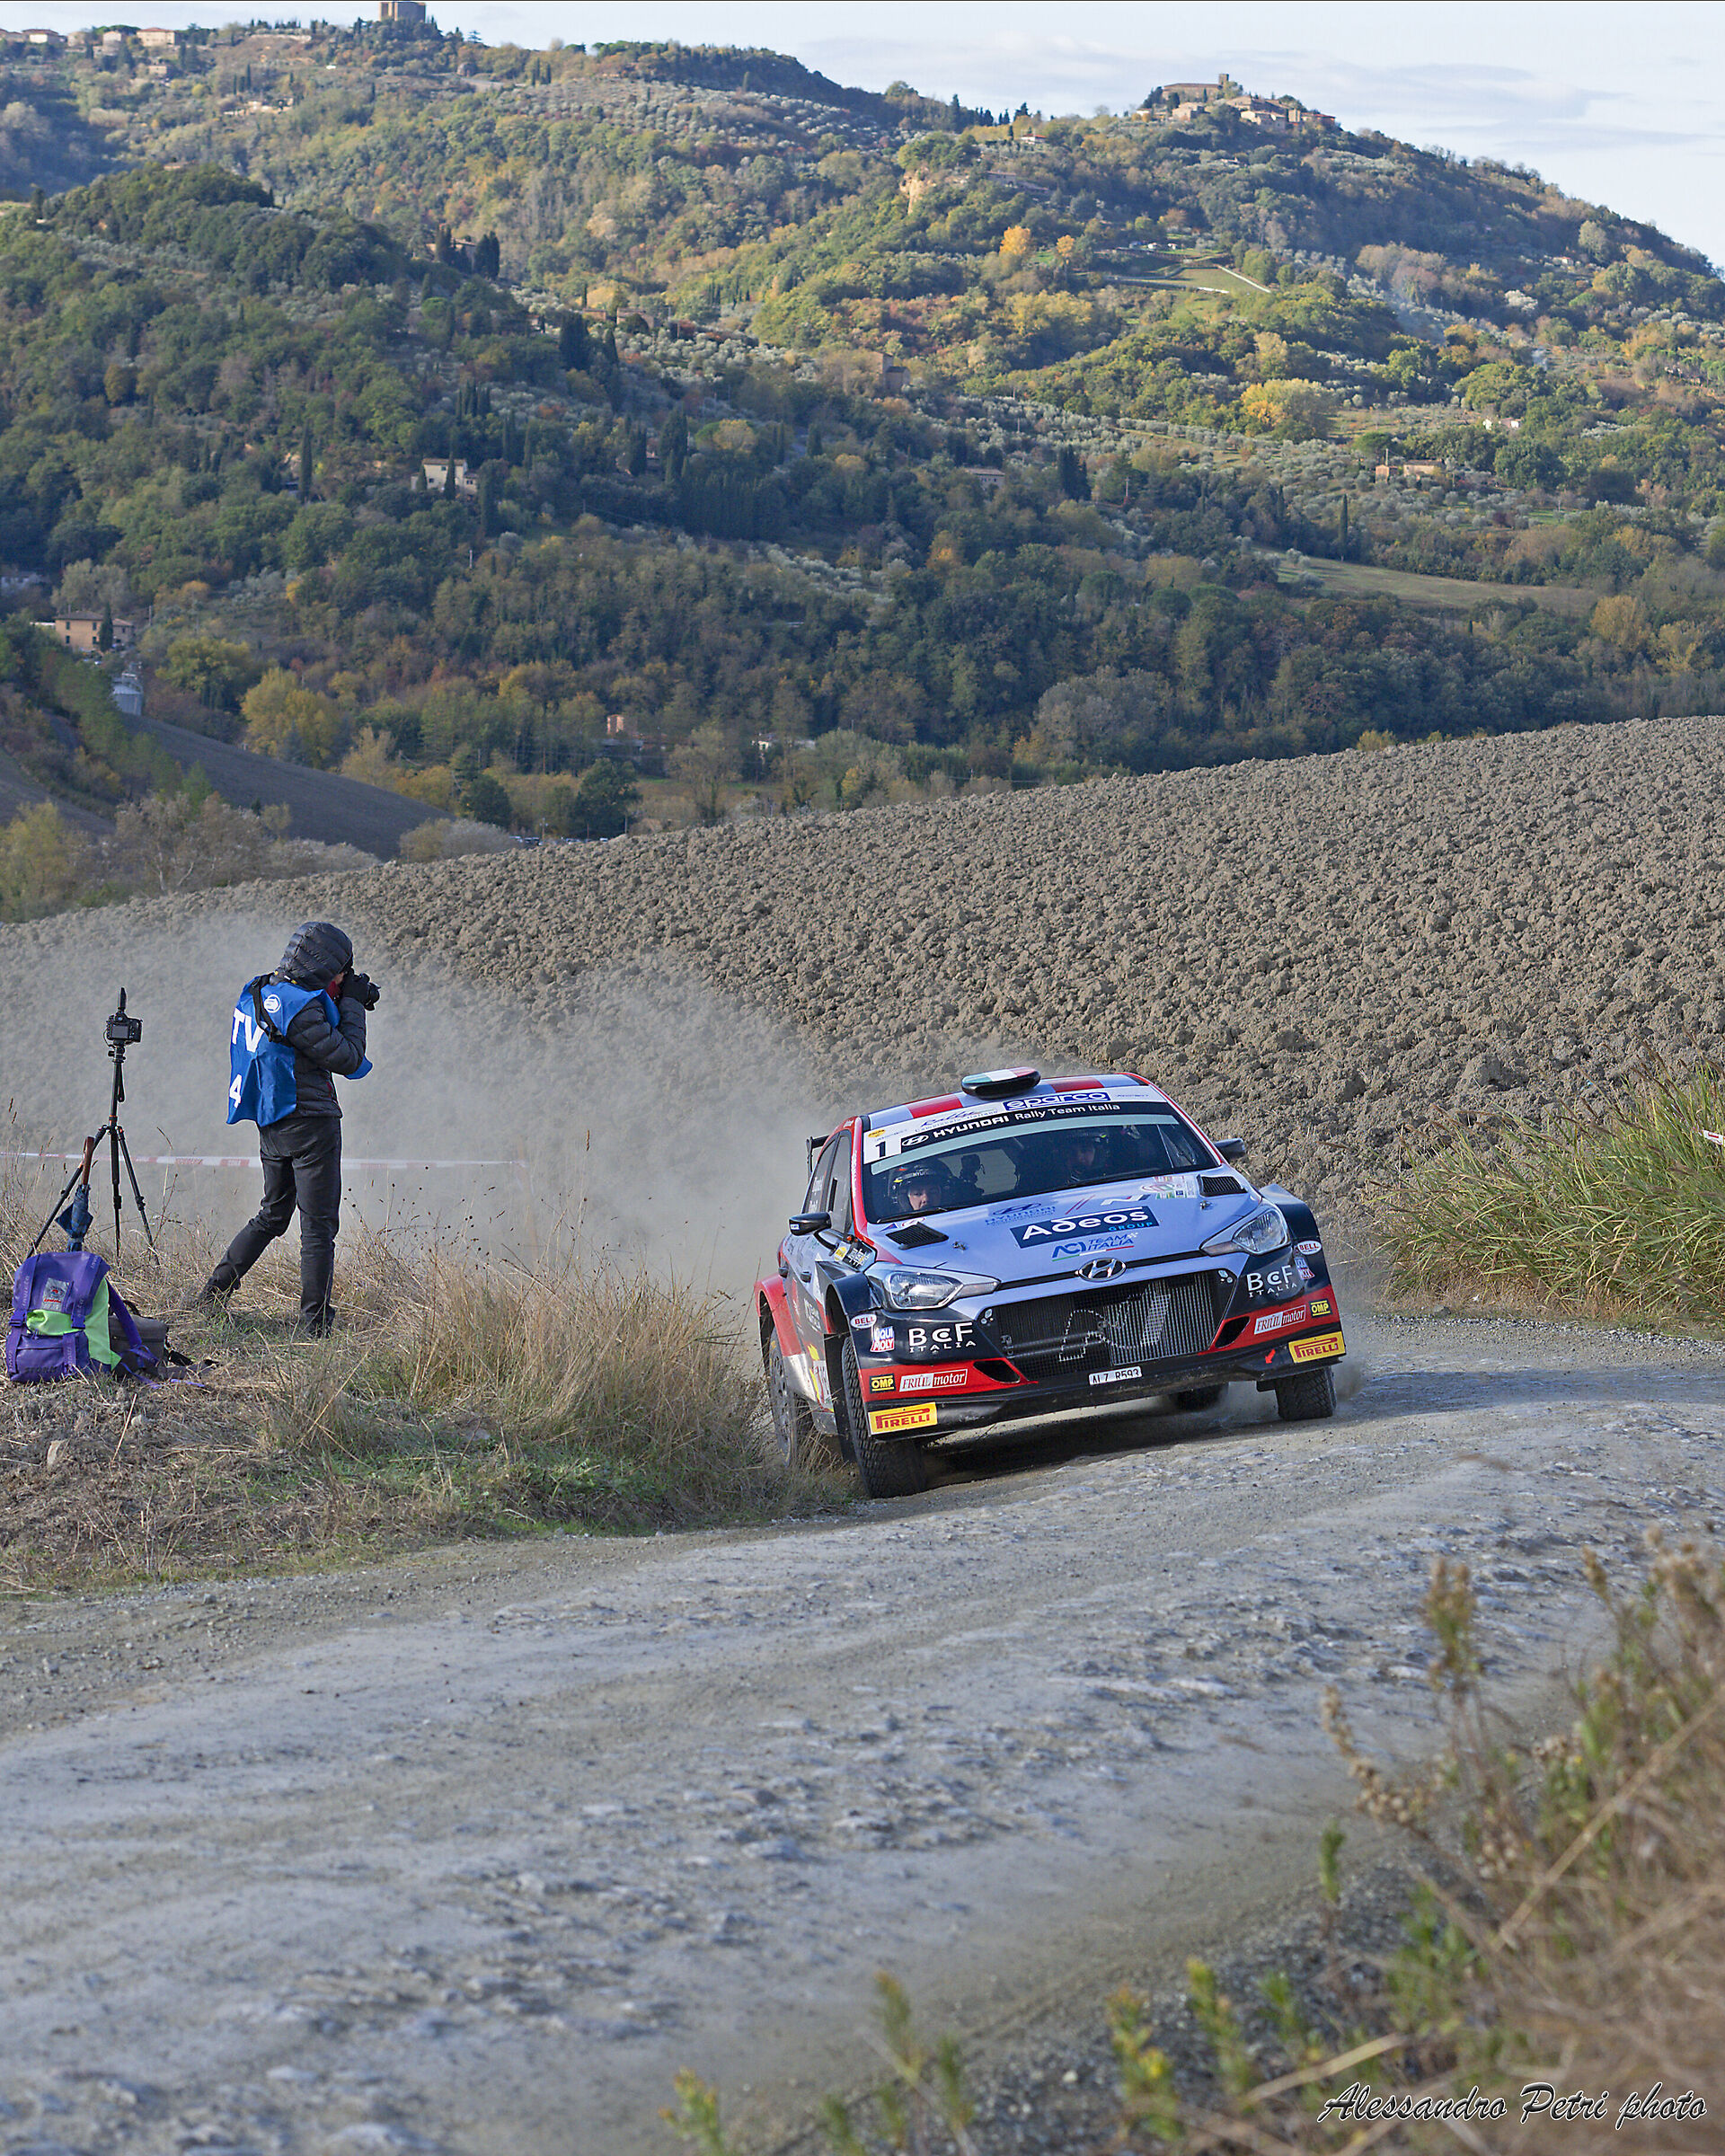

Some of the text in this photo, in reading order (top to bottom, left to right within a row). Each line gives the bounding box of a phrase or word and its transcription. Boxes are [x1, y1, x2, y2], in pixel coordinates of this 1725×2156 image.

[232, 1007, 264, 1053] TV
[229, 1074, 242, 1108] 4
[1004, 1092, 1110, 1110] sparco
[933, 1103, 1120, 1138] HYUNDAI Rally Team Italia
[875, 1141, 886, 1158] 1
[1108, 1222, 1153, 1232] GROUP
[1088, 1233, 1128, 1243] TEAM
[1088, 1239, 1134, 1250] ITALIA
[1249, 1283, 1297, 1298] ITALIA
[1312, 1305, 1329, 1313] OMP
[1281, 1311, 1305, 1325] motor
[909, 1340, 977, 1354] ITALIA
[1294, 1338, 1339, 1358] PIRELLI
[871, 1377, 893, 1387] OMP
[933, 1372, 965, 1385] motor
[875, 1408, 931, 1429] PIRELLI
